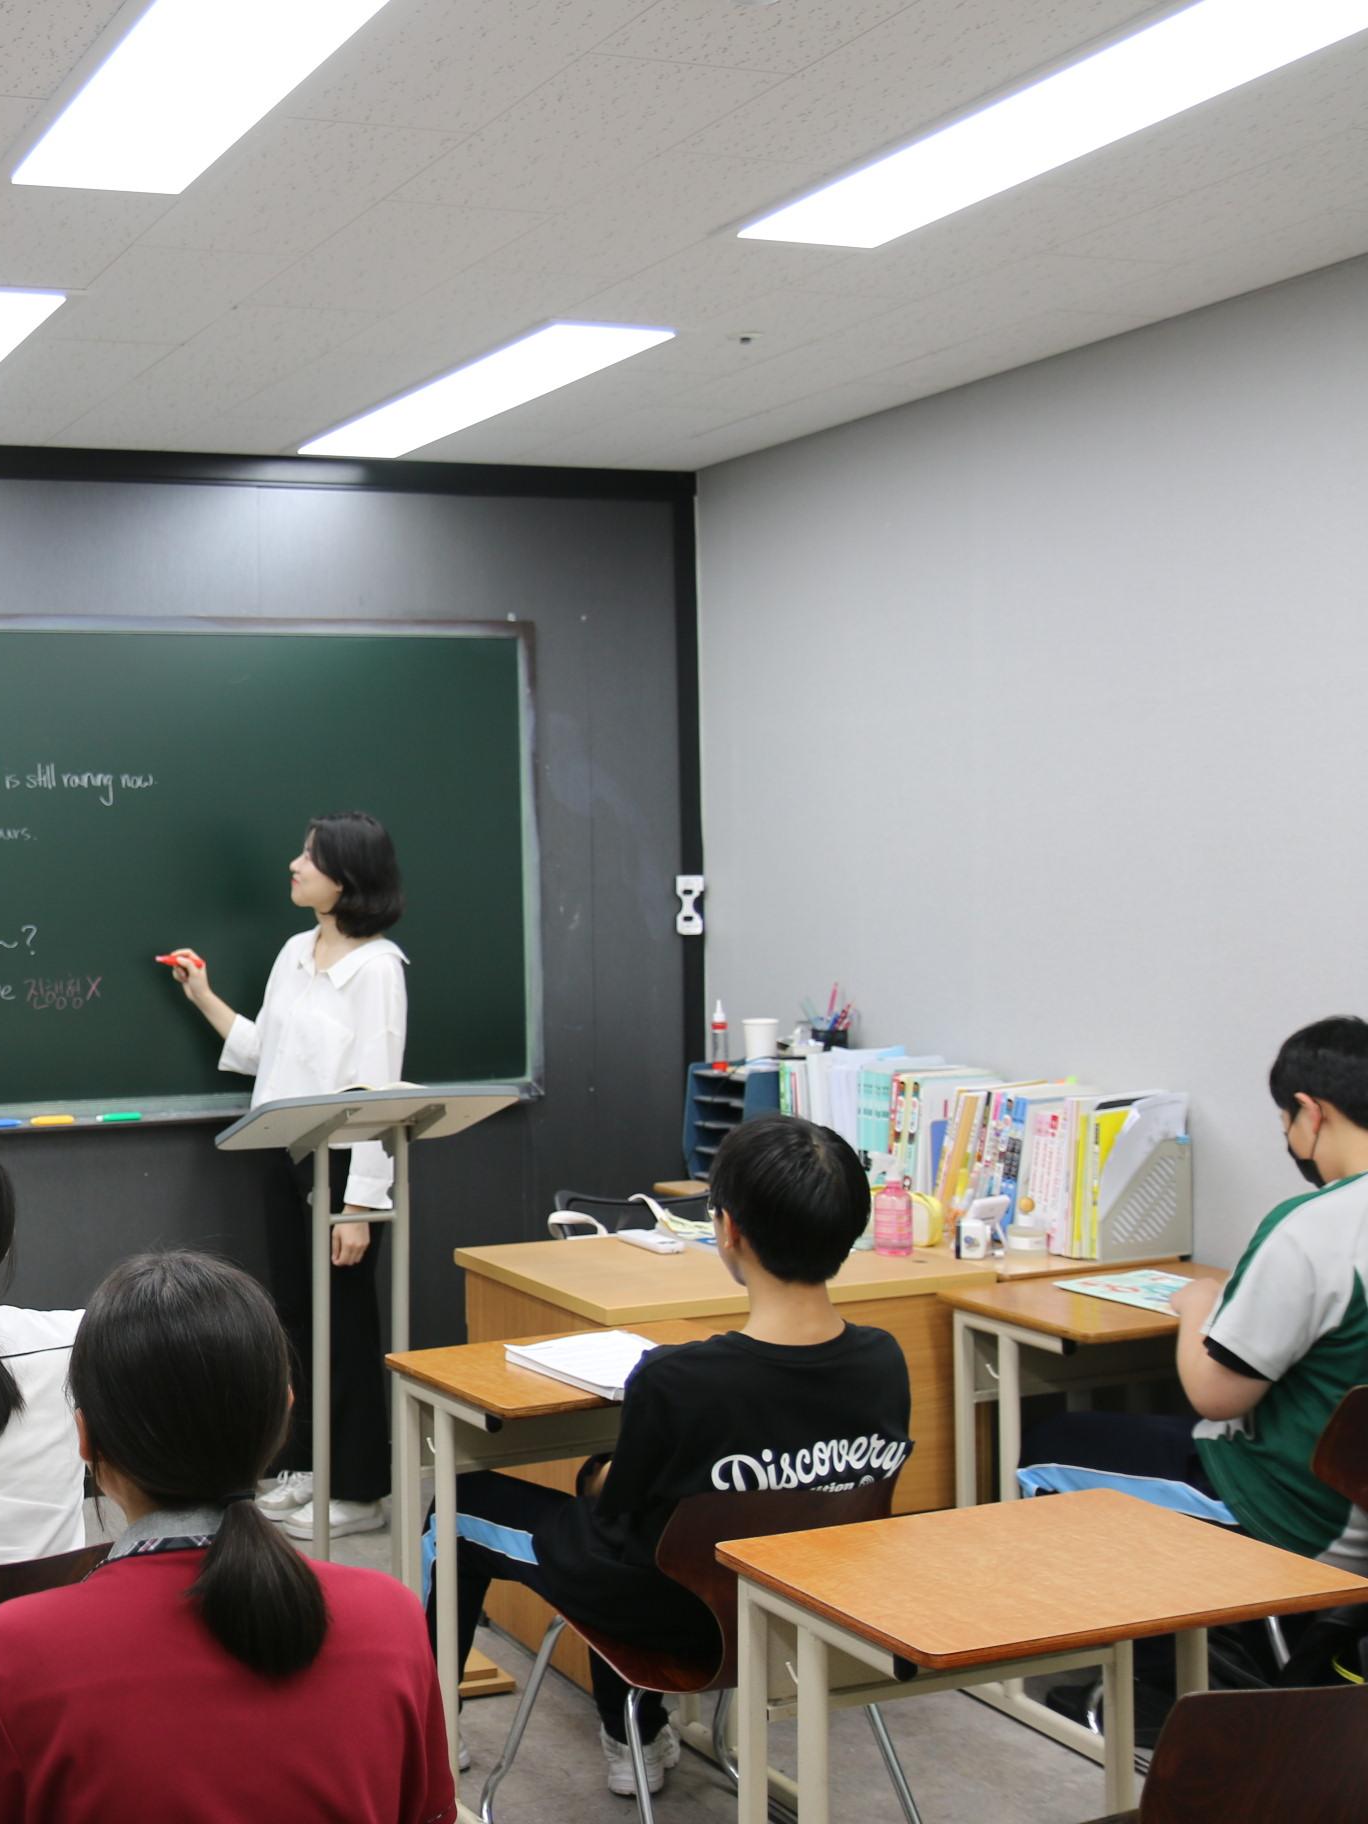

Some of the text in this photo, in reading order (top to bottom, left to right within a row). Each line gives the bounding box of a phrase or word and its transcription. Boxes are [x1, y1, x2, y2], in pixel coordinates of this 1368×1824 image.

[5, 773, 20, 789] is
[26, 762, 56, 790] still
[711, 1433, 906, 1492] Discovery
